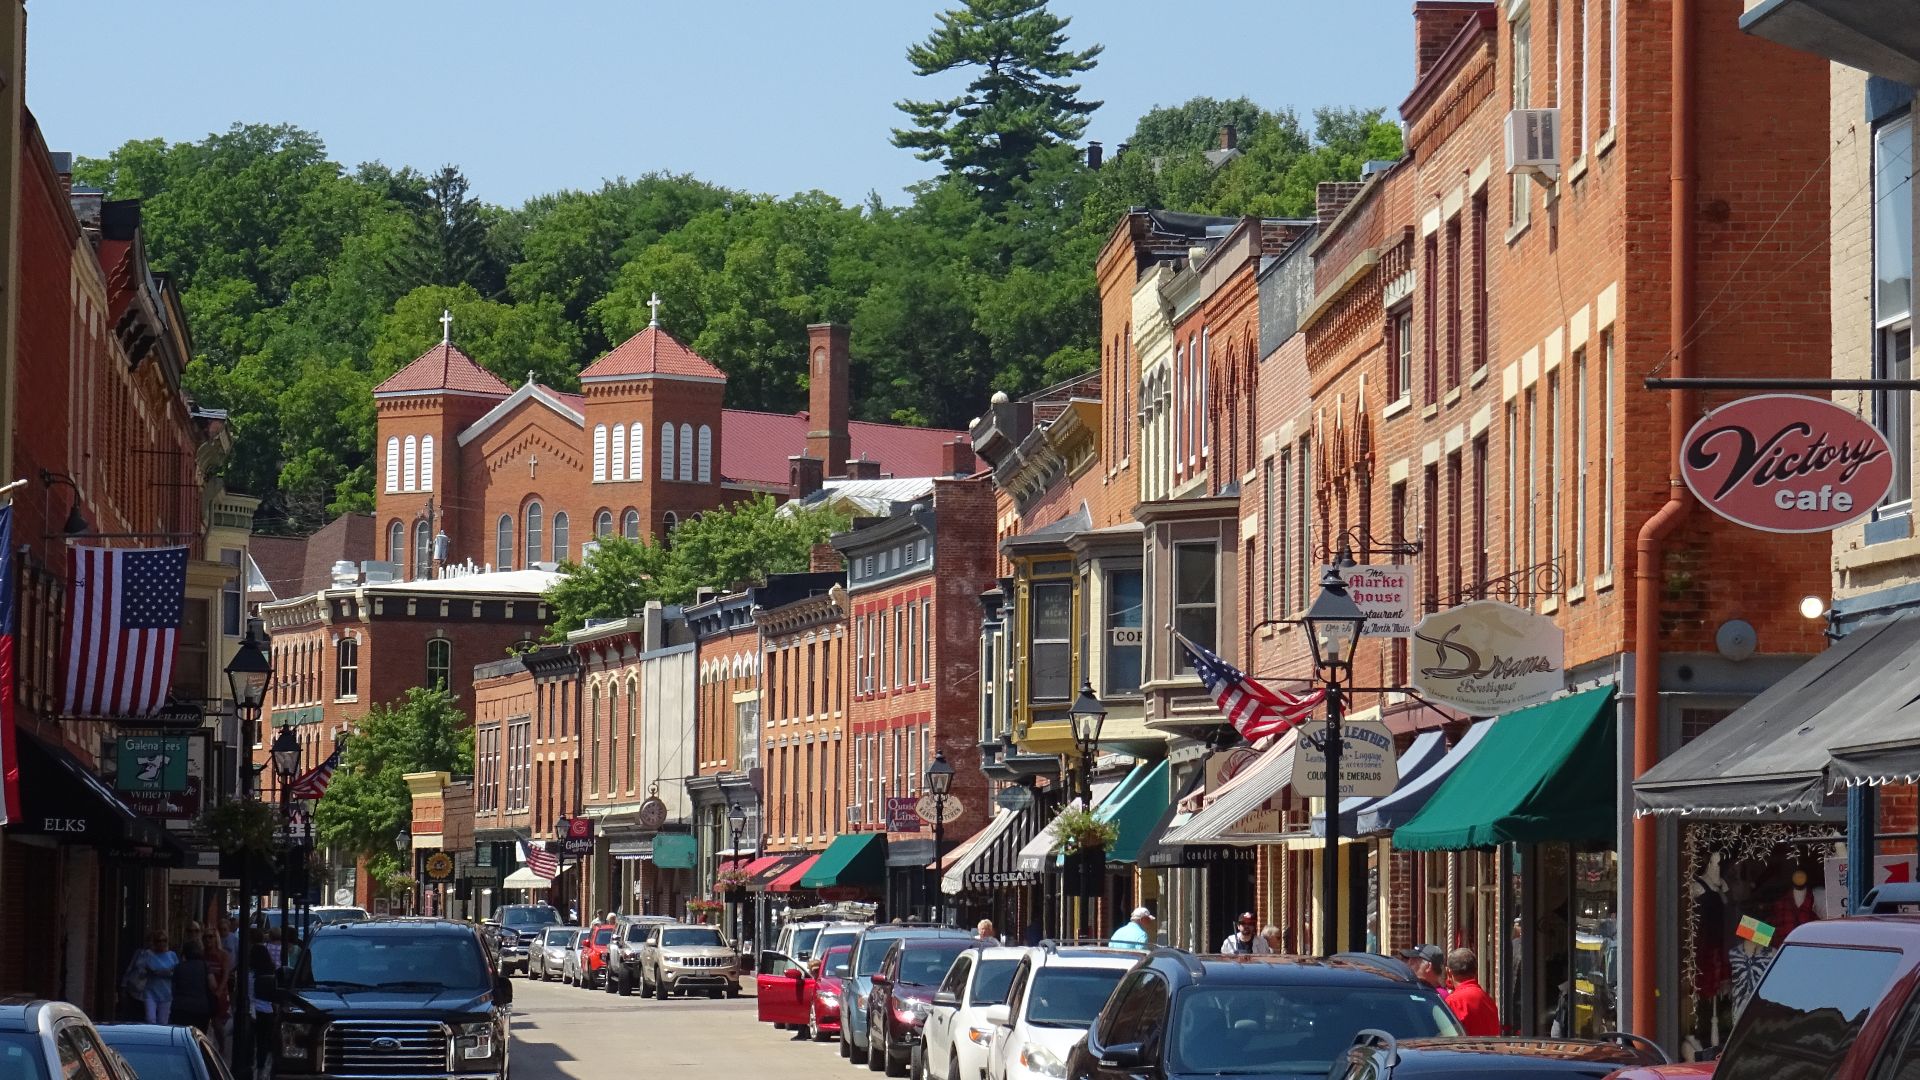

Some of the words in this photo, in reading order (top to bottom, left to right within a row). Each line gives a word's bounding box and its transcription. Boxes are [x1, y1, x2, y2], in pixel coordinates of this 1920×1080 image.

[1688, 422, 1888, 502] Victory
[1774, 485, 1854, 512] cafe
[1366, 568, 1384, 578] The
[1349, 575, 1404, 588] Market
[1361, 608, 1405, 619] staurant
[1415, 624, 1559, 680] Dreams
[1457, 679, 1516, 698] Boutique
[125, 739, 158, 751] Galena
[1344, 726, 1391, 752] LEATHER
[1347, 771, 1382, 781] EMERALDS
[895, 810, 920, 821] Lines
[43, 818, 86, 832] ELKS
[572, 820, 586, 834] G
[565, 838, 593, 851] Gabby's
[1186, 848, 1217, 860] candle
[1234, 848, 1255, 860] bath
[970, 873, 991, 883] ICE
[993, 871, 1035, 882] CREAM
